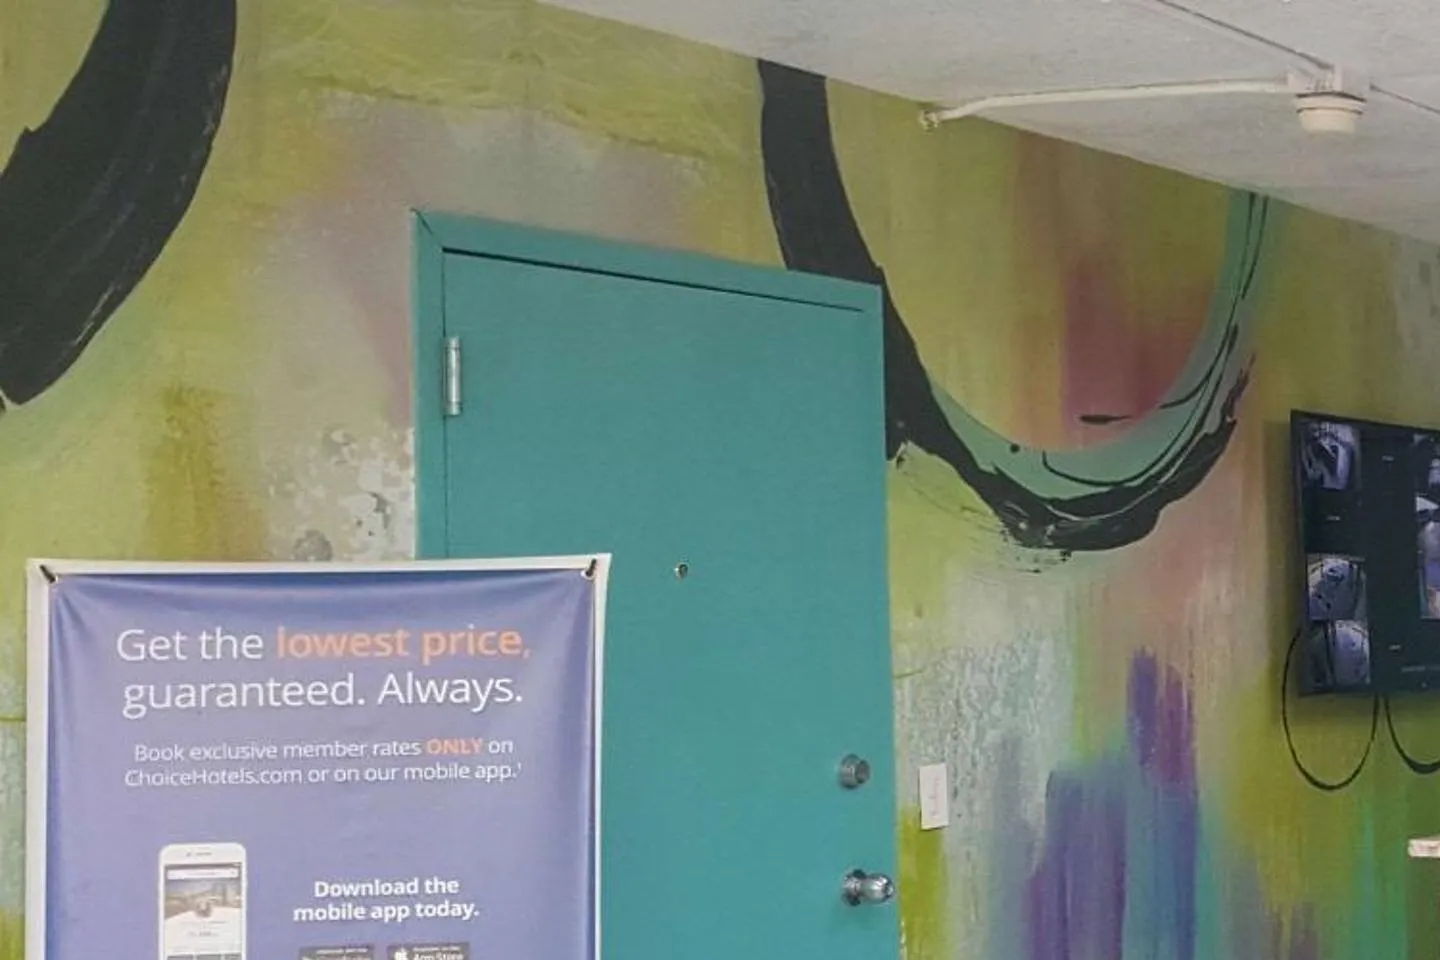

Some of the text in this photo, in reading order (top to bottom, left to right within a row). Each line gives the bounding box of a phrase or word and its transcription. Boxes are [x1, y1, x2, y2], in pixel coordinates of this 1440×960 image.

[116, 624, 533, 665] Get the lowest price,
[122, 671, 522, 719] guaranteed. Always.
[134, 738, 514, 762] Book exclusive member rates ONLY on
[124, 767, 302, 787] ChoiceHotels.com
[308, 768, 329, 784] or
[334, 767, 359, 782] on
[364, 766, 399, 782] our
[404, 762, 471, 781] mobile
[314, 876, 460, 898] Download the
[293, 900, 480, 924] mobile app today.
